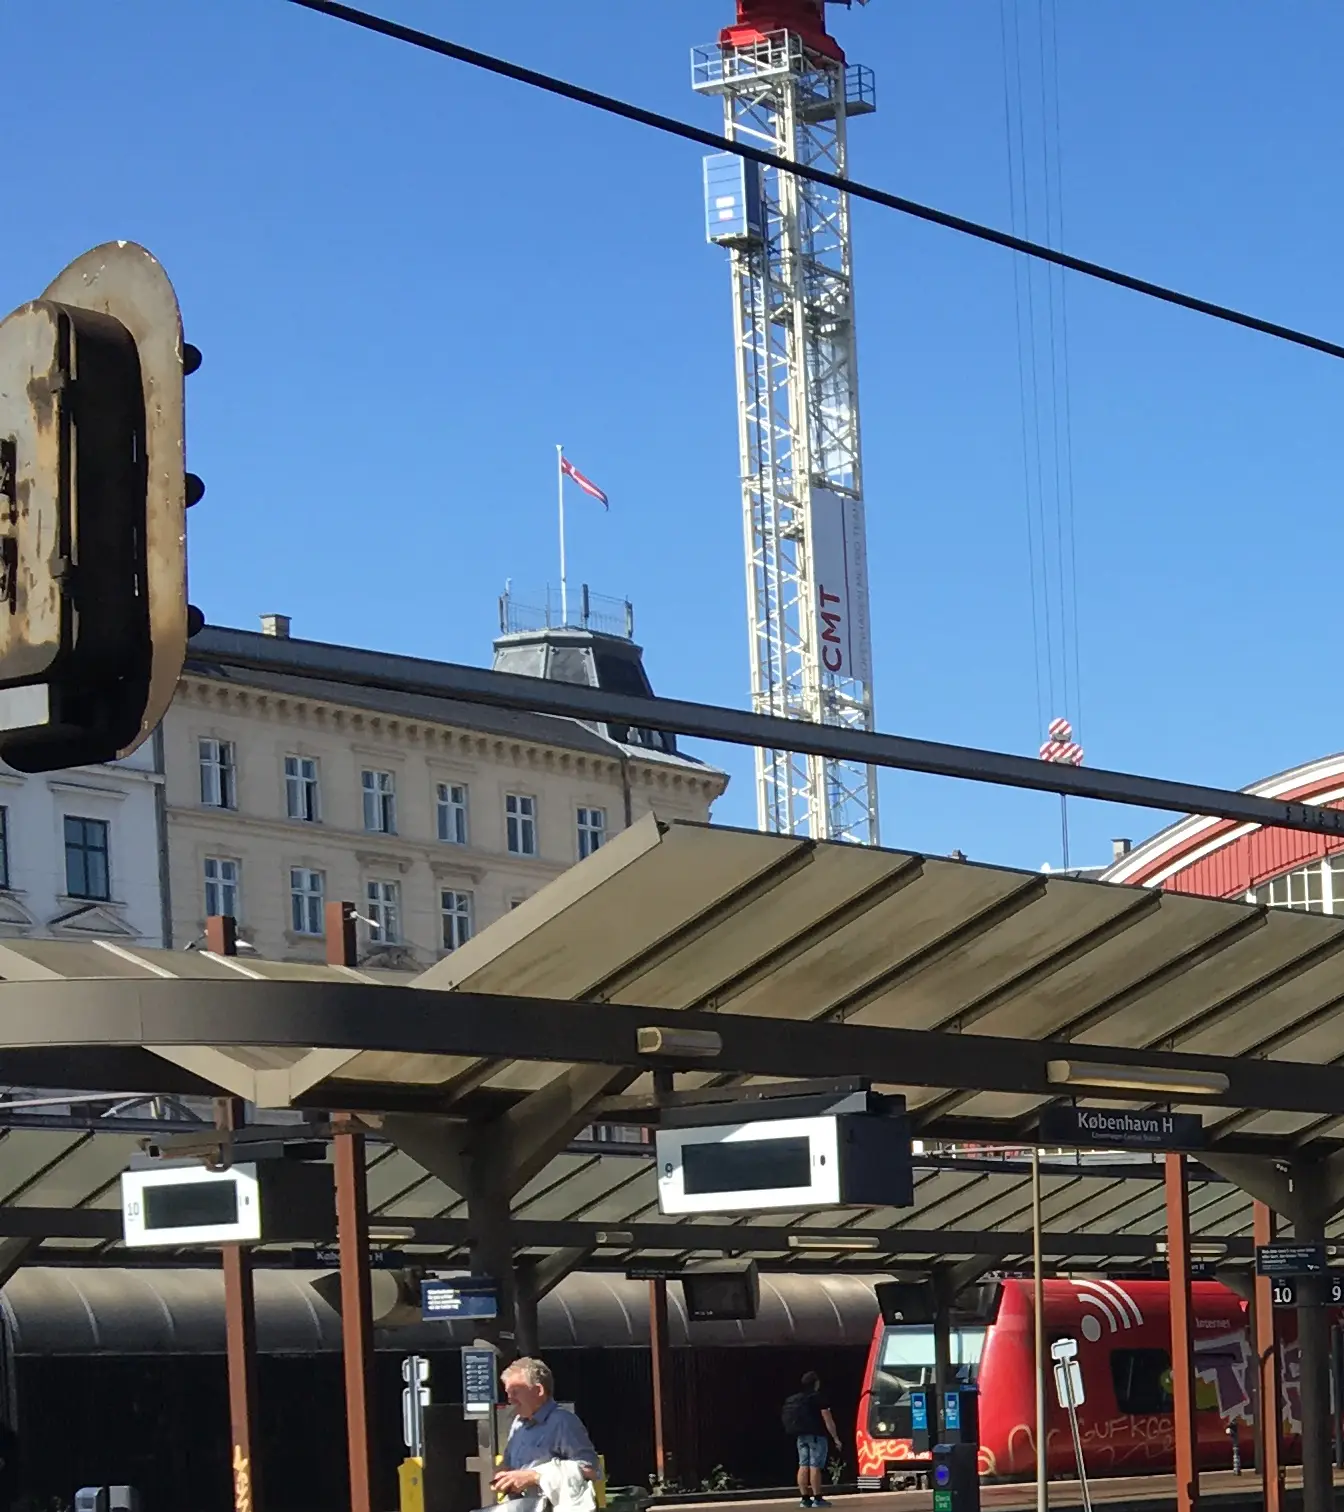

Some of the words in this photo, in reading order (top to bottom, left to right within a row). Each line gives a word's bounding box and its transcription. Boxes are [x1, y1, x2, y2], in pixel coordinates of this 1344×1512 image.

[819, 584, 842, 672] CMT
[1077, 1112, 1159, 1132] København
[1163, 1117, 1173, 1133] H
[665, 1162, 673, 1178] 9
[127, 1202, 140, 1216] 10
[1273, 1287, 1292, 1303] 10
[1331, 1285, 1342, 1302] 9
